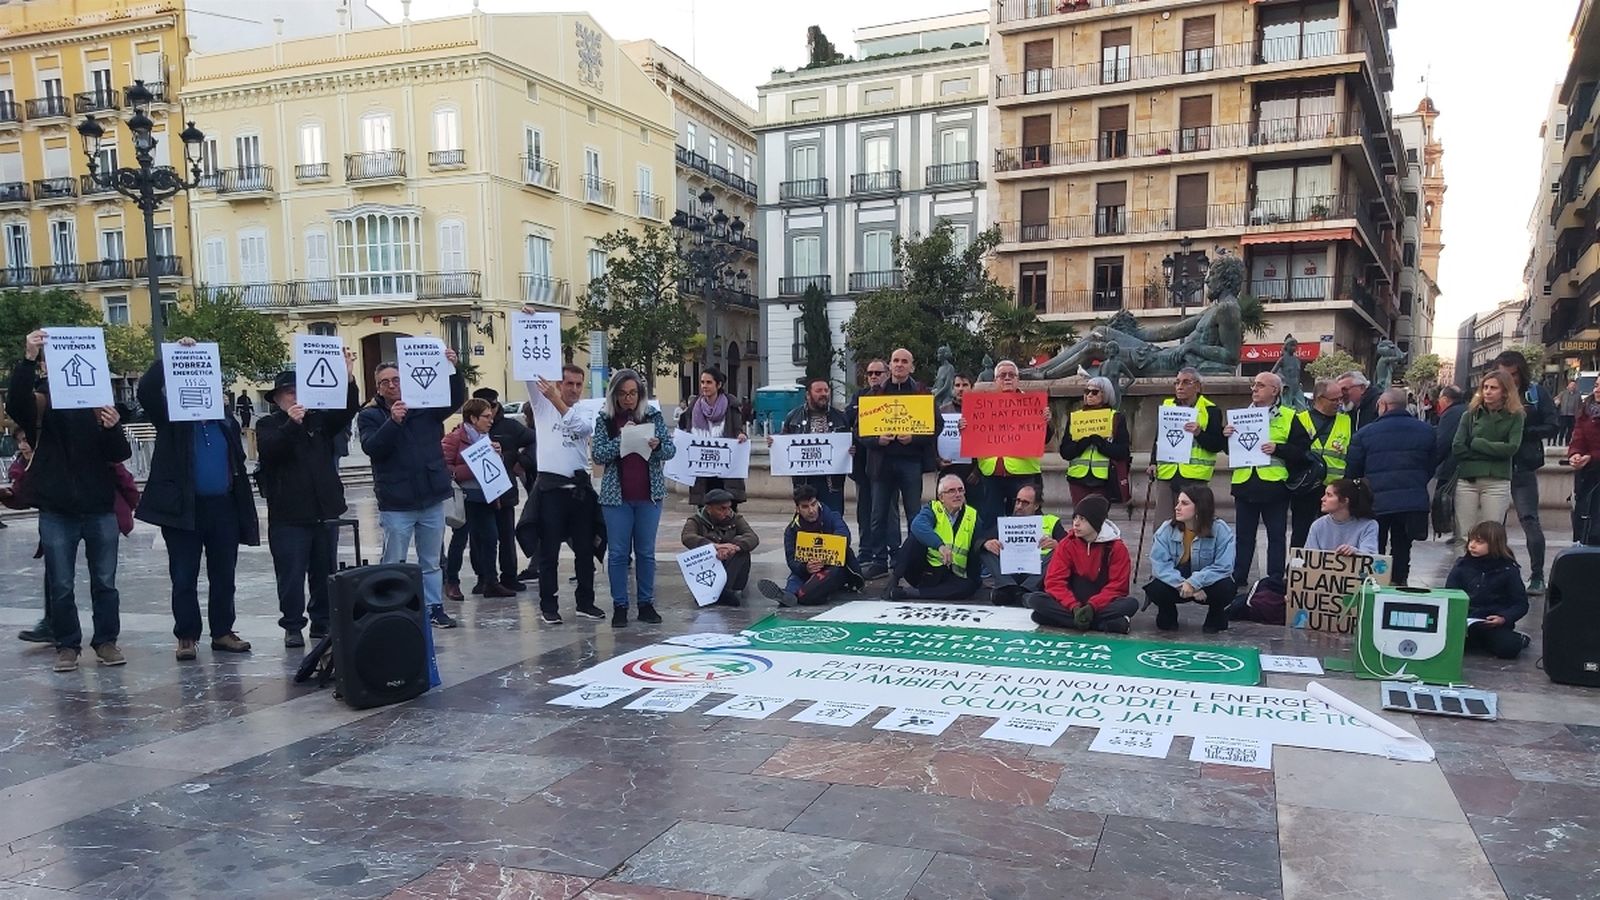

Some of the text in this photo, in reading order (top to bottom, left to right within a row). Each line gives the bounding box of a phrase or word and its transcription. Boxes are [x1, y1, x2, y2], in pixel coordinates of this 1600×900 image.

[1261, 347, 1312, 358] Sander
[172, 361, 213, 369] POBREZA
[975, 396, 1041, 410] SIN PLANETA
[972, 408, 1044, 421] NO HAY FUTURO
[972, 424, 994, 432] POR
[999, 423, 1016, 431] MIS
[987, 434, 1021, 444] LUCHO
[700, 452, 721, 461] ZERO
[801, 451, 822, 460] ZERO
[873, 629, 1112, 653] SENSE PLANETA
[858, 637, 1111, 660] NO HI HA FUTUR
[951, 652, 1023, 662] FUTURE
[821, 660, 960, 678] PLATAFORMA
[965, 671, 1012, 682] PER
[1018, 676, 1052, 686] UN
[1056, 680, 1110, 691] NOU
[1116, 684, 1203, 699] MODEL
[786, 668, 858, 682] MEDI
[857, 674, 984, 694] AMBIENT,
[993, 685, 1064, 700] NOU
[1071, 692, 1181, 711] MODEL
[942, 695, 1105, 721] OCUPACIÓ,
[1115, 711, 1173, 726] JA!!
[1004, 723, 1052, 731] JUSTA
